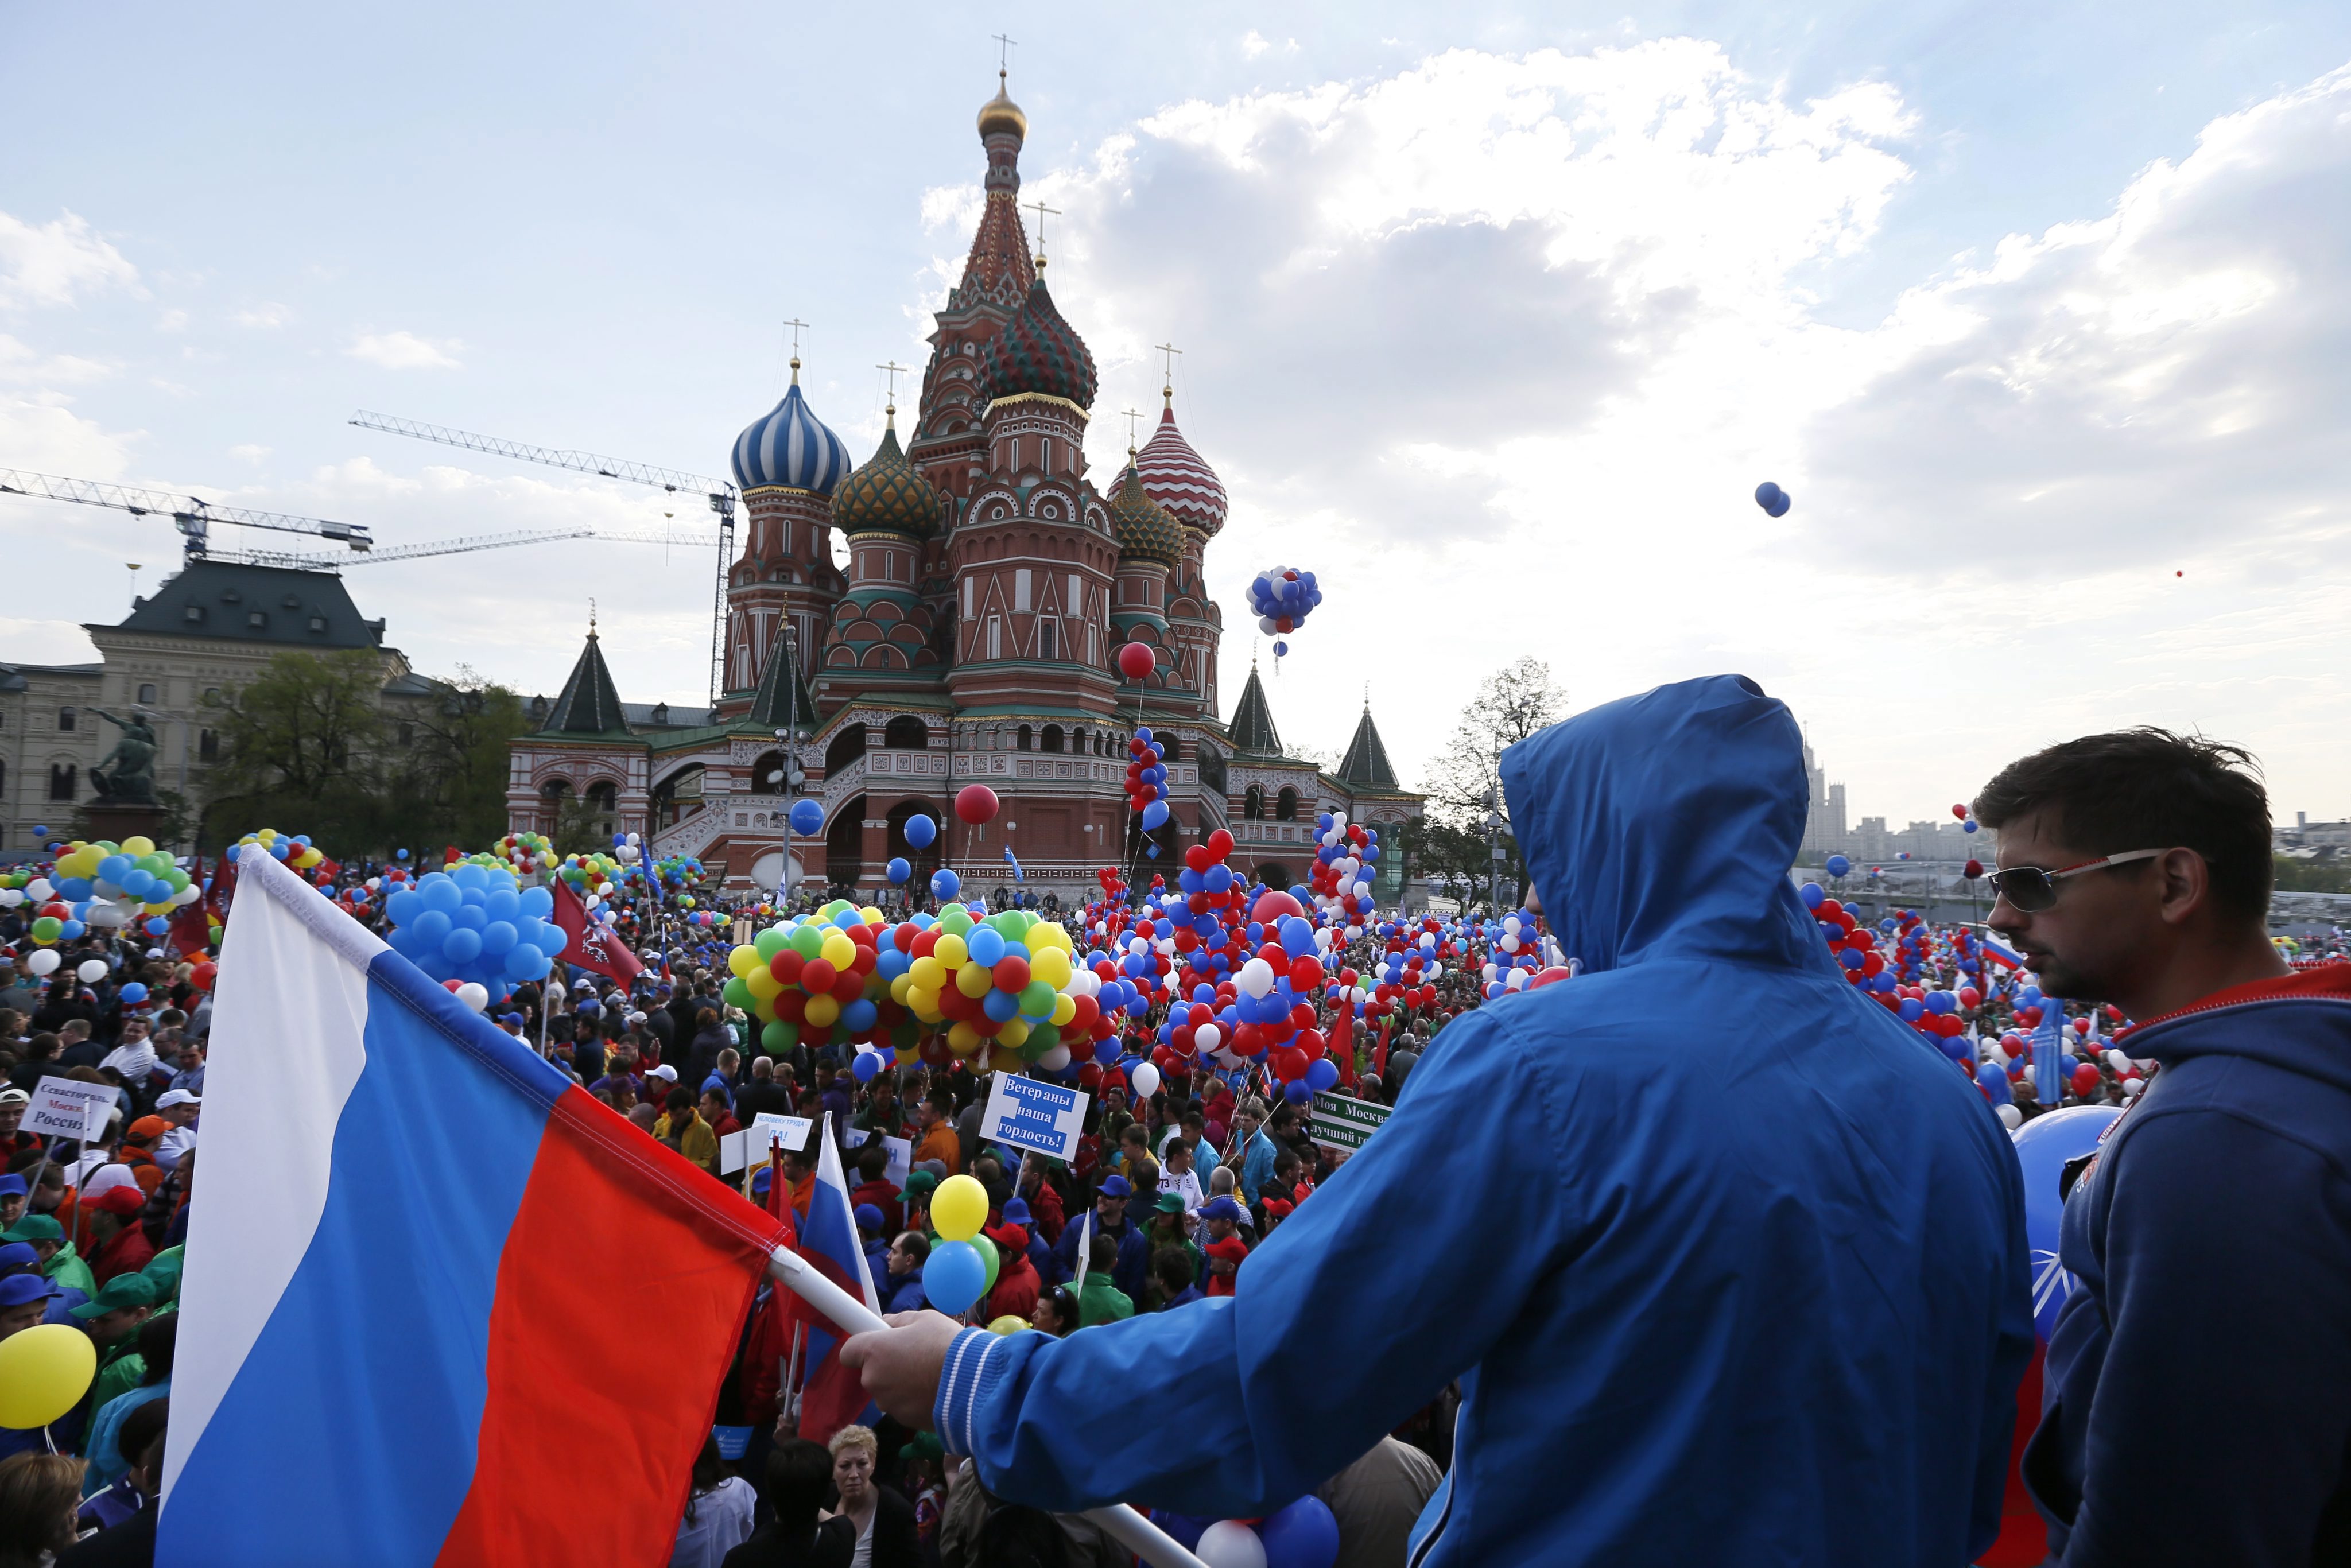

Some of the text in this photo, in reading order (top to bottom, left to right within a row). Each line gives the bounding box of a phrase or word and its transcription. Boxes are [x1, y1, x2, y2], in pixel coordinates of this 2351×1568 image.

[1005, 1078, 1071, 1107] Ветераны
[1313, 1096, 1337, 1112] Моя
[758, 1115, 786, 1124] ЧЕЛОВЕКУ
[1017, 1106, 1052, 1123] наша
[998, 1123, 1061, 1147] гордость!
[1310, 1124, 1369, 1144] лучший го
